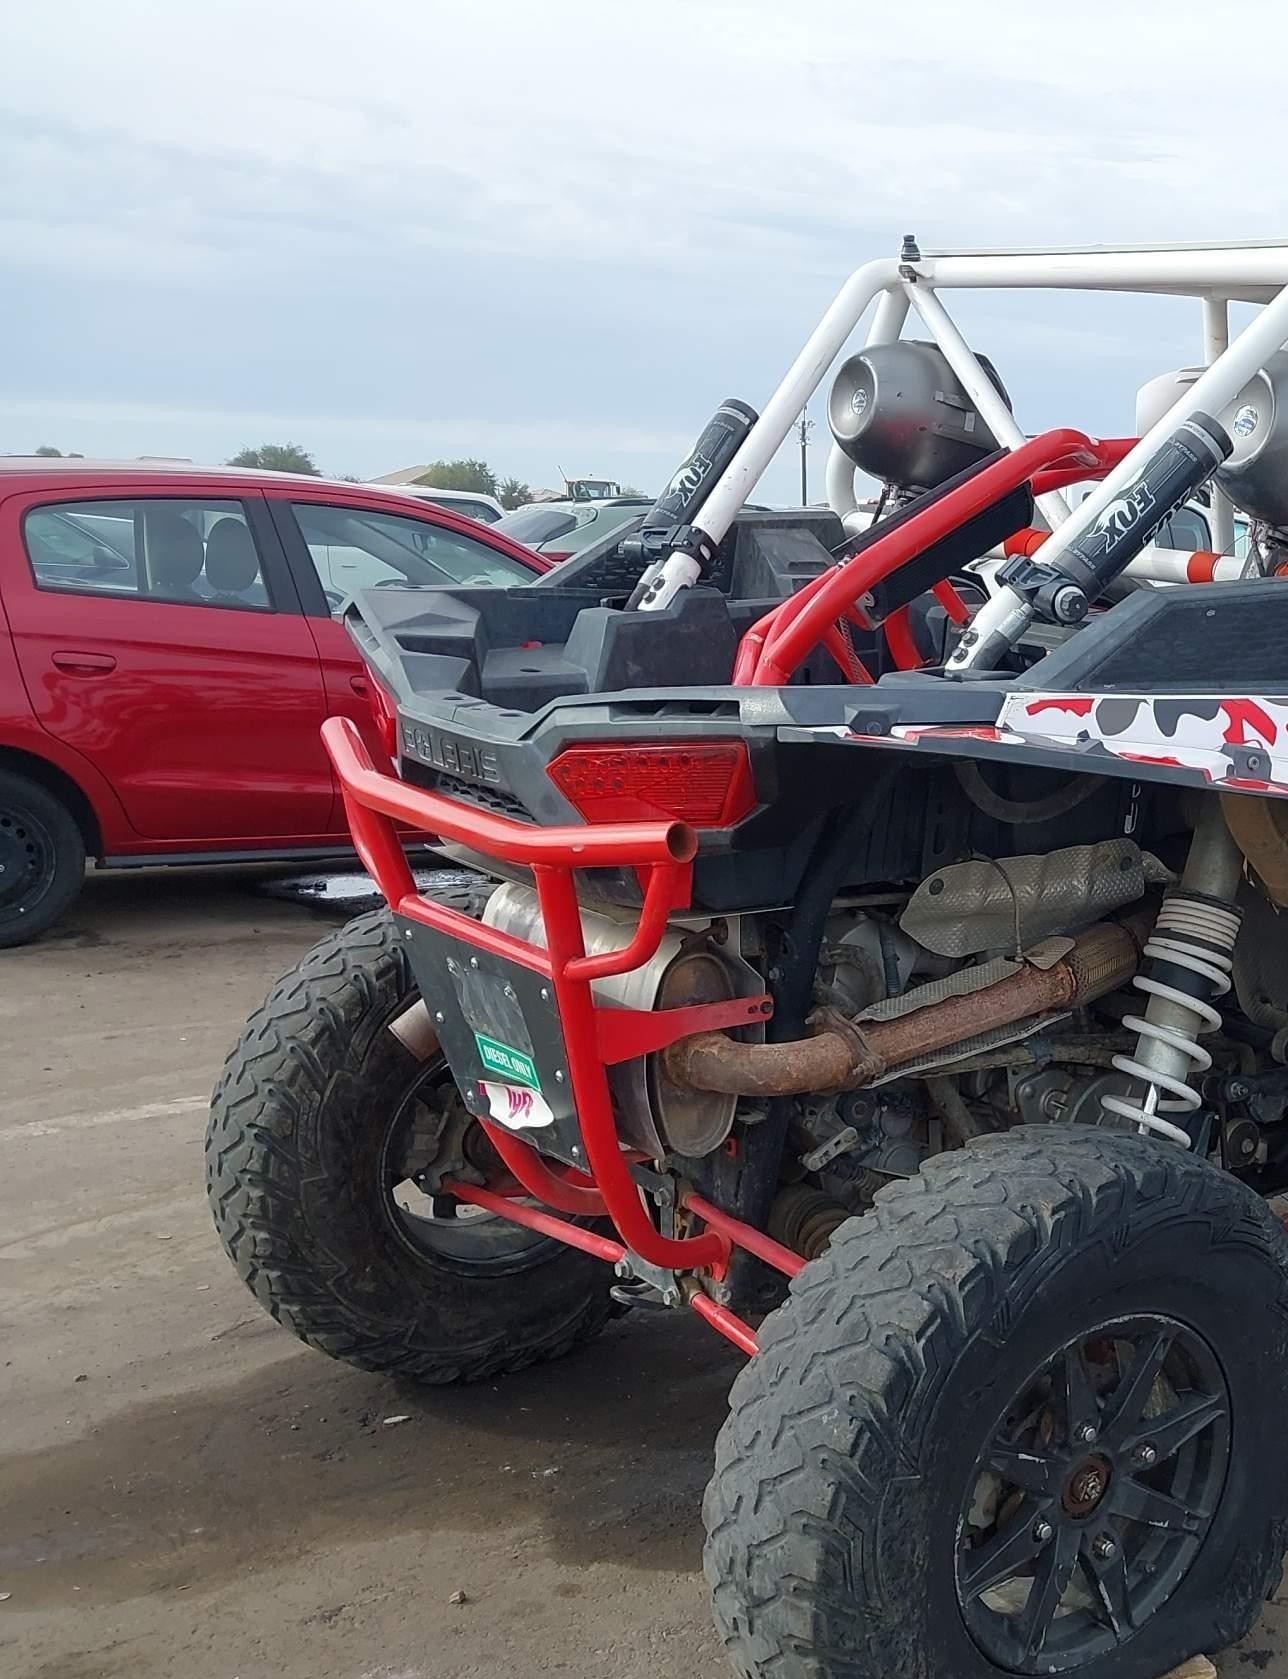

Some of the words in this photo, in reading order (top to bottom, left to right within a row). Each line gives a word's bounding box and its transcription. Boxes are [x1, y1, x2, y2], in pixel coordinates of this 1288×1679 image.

[675, 453, 713, 508] FOX
[1098, 480, 1156, 554] FOX
[400, 721, 499, 783] POLARIS
[482, 1044, 513, 1070] DIESEL
[511, 1057, 533, 1080] ONLY
